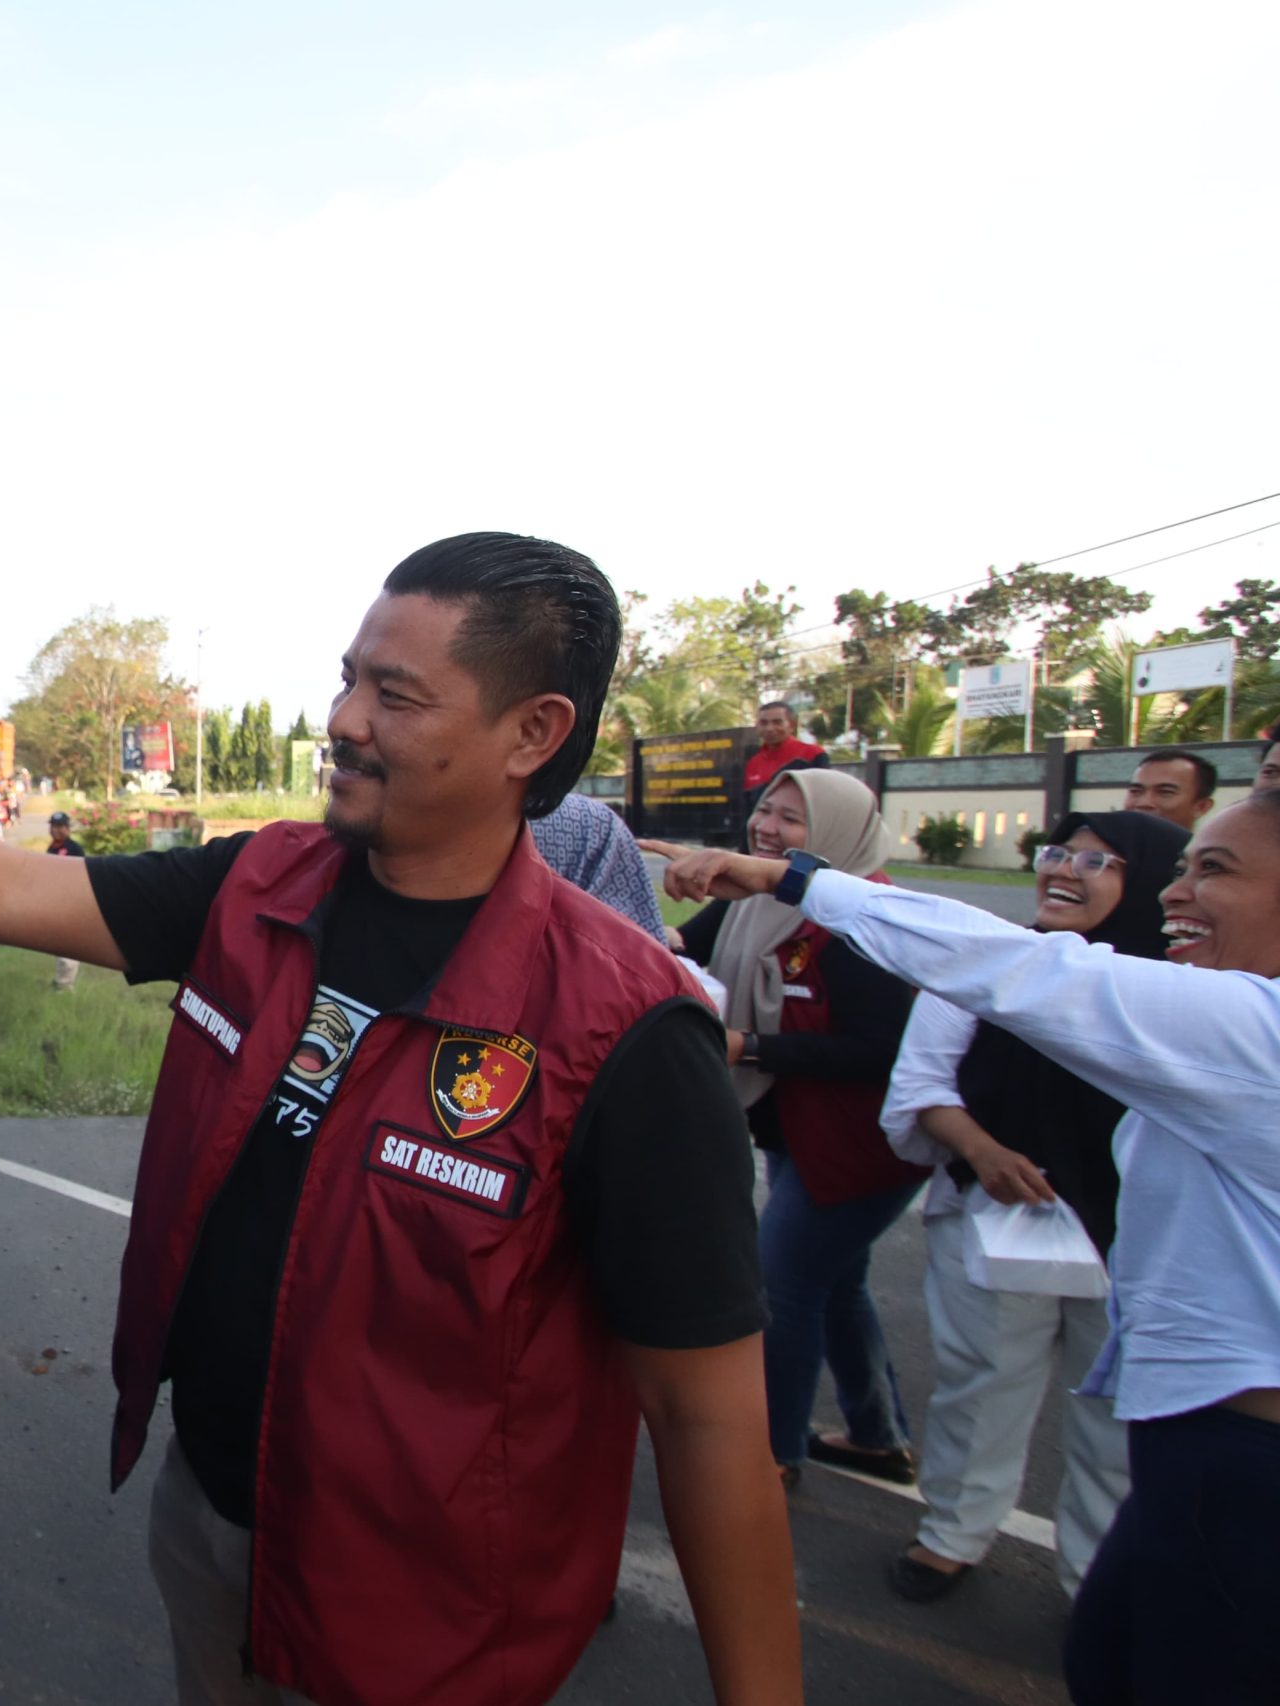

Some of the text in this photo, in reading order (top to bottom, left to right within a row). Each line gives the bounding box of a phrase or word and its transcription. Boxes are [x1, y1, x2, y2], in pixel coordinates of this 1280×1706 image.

[180, 987, 241, 1055] SIMATUPANG
[380, 1135, 506, 1202] SAT RESKRIM
